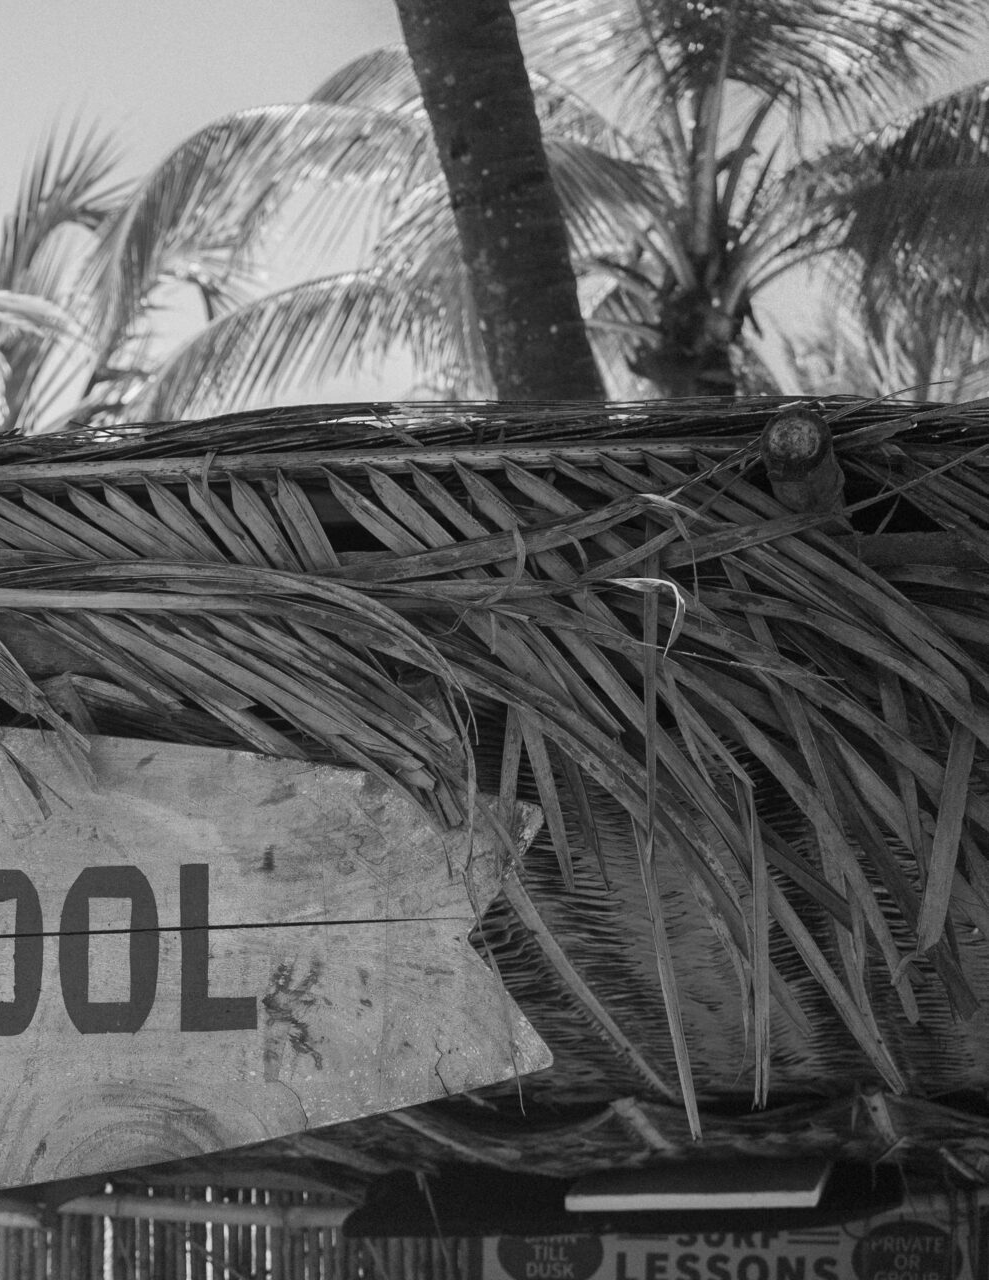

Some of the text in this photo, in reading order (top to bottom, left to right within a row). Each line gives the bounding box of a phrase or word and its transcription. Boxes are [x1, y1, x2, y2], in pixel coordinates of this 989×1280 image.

[531, 1244, 570, 1261] TILL
[870, 1235, 945, 1254] PRIVATE
[525, 1260, 575, 1279] DUSK
[893, 1253, 922, 1271] OR
